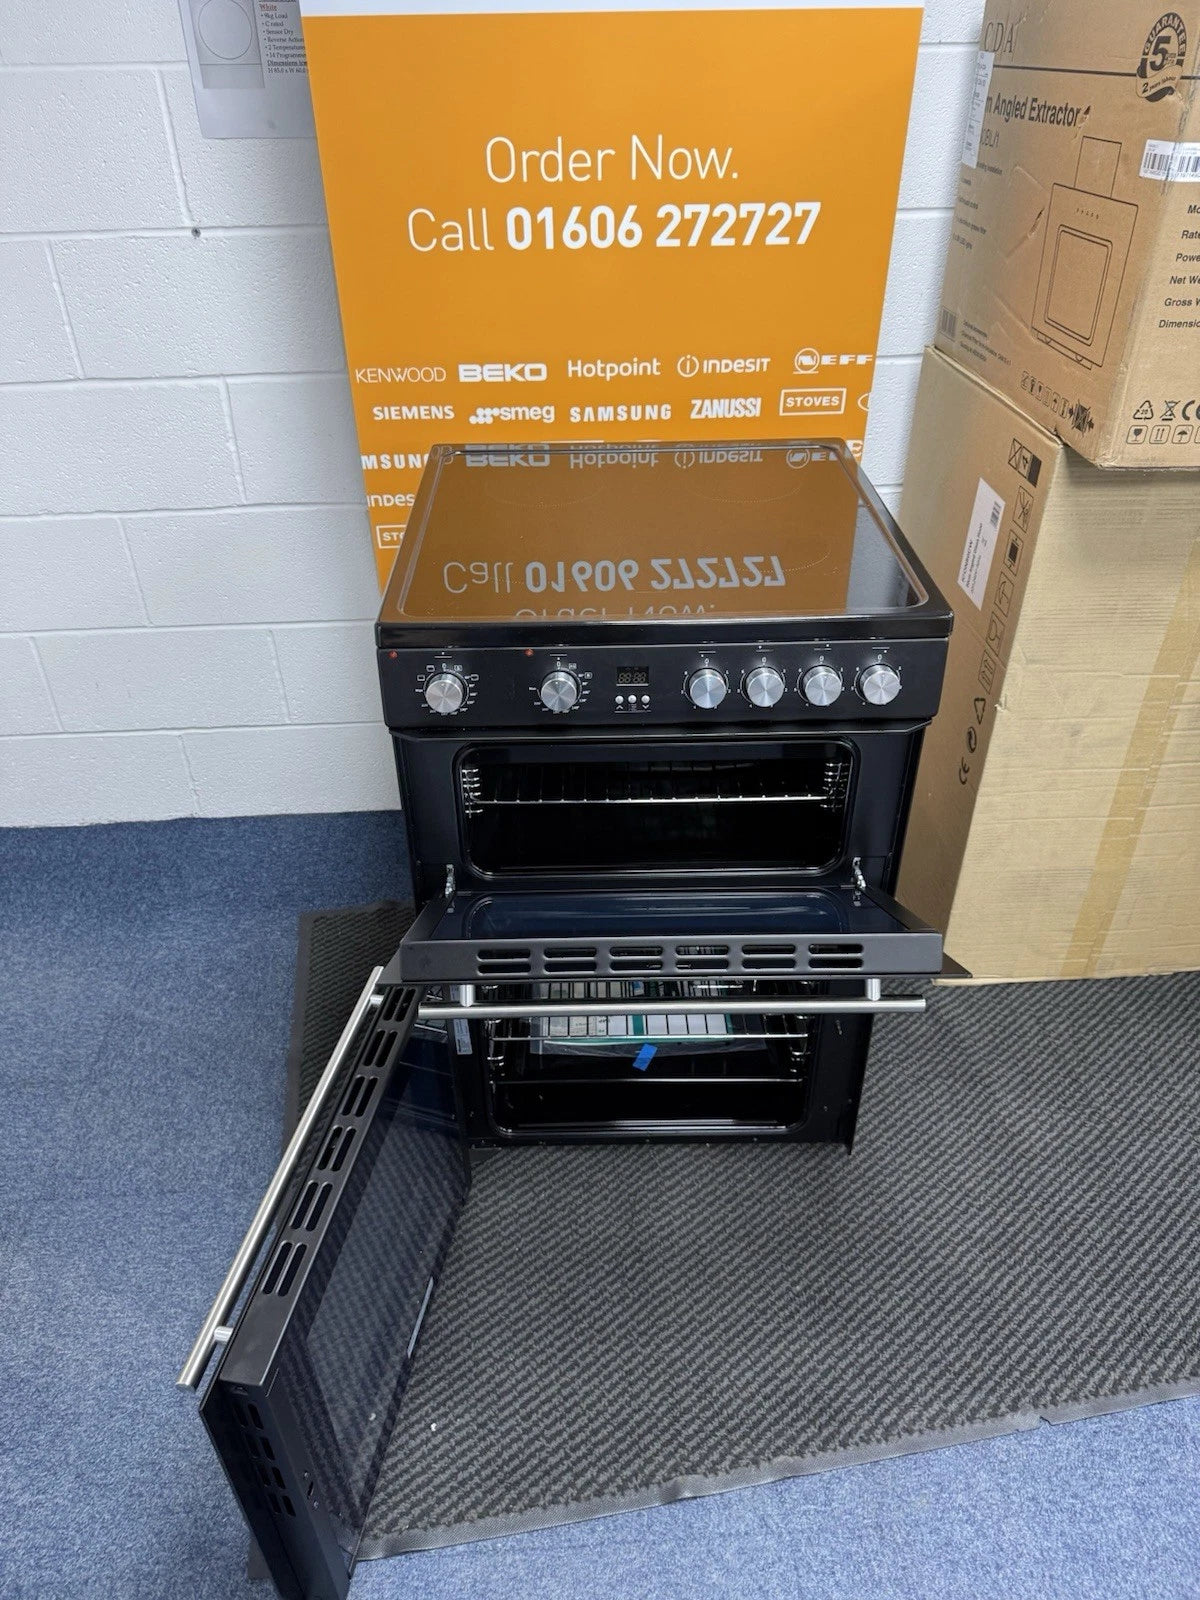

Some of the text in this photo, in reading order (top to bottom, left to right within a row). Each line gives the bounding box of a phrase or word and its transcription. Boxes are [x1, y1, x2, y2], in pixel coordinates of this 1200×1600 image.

[1149, 35, 1172, 72] 5
[1142, 82, 1149, 94] 2
[993, 92, 1029, 123] Angled
[1028, 97, 1082, 127] Extractor
[486, 133, 740, 184] Order Now.
[407, 201, 822, 253] Call 01606 272727
[1169, 275, 1187, 285] Net
[1164, 297, 1193, 307] Gross
[355, 366, 447, 384] KENWOOD
[458, 363, 548, 383] BEKO
[567, 357, 661, 382] Hotpoint
[372, 395, 840, 424] SIEMENS smeg SAMSUNG ZANUSSI STOVES
